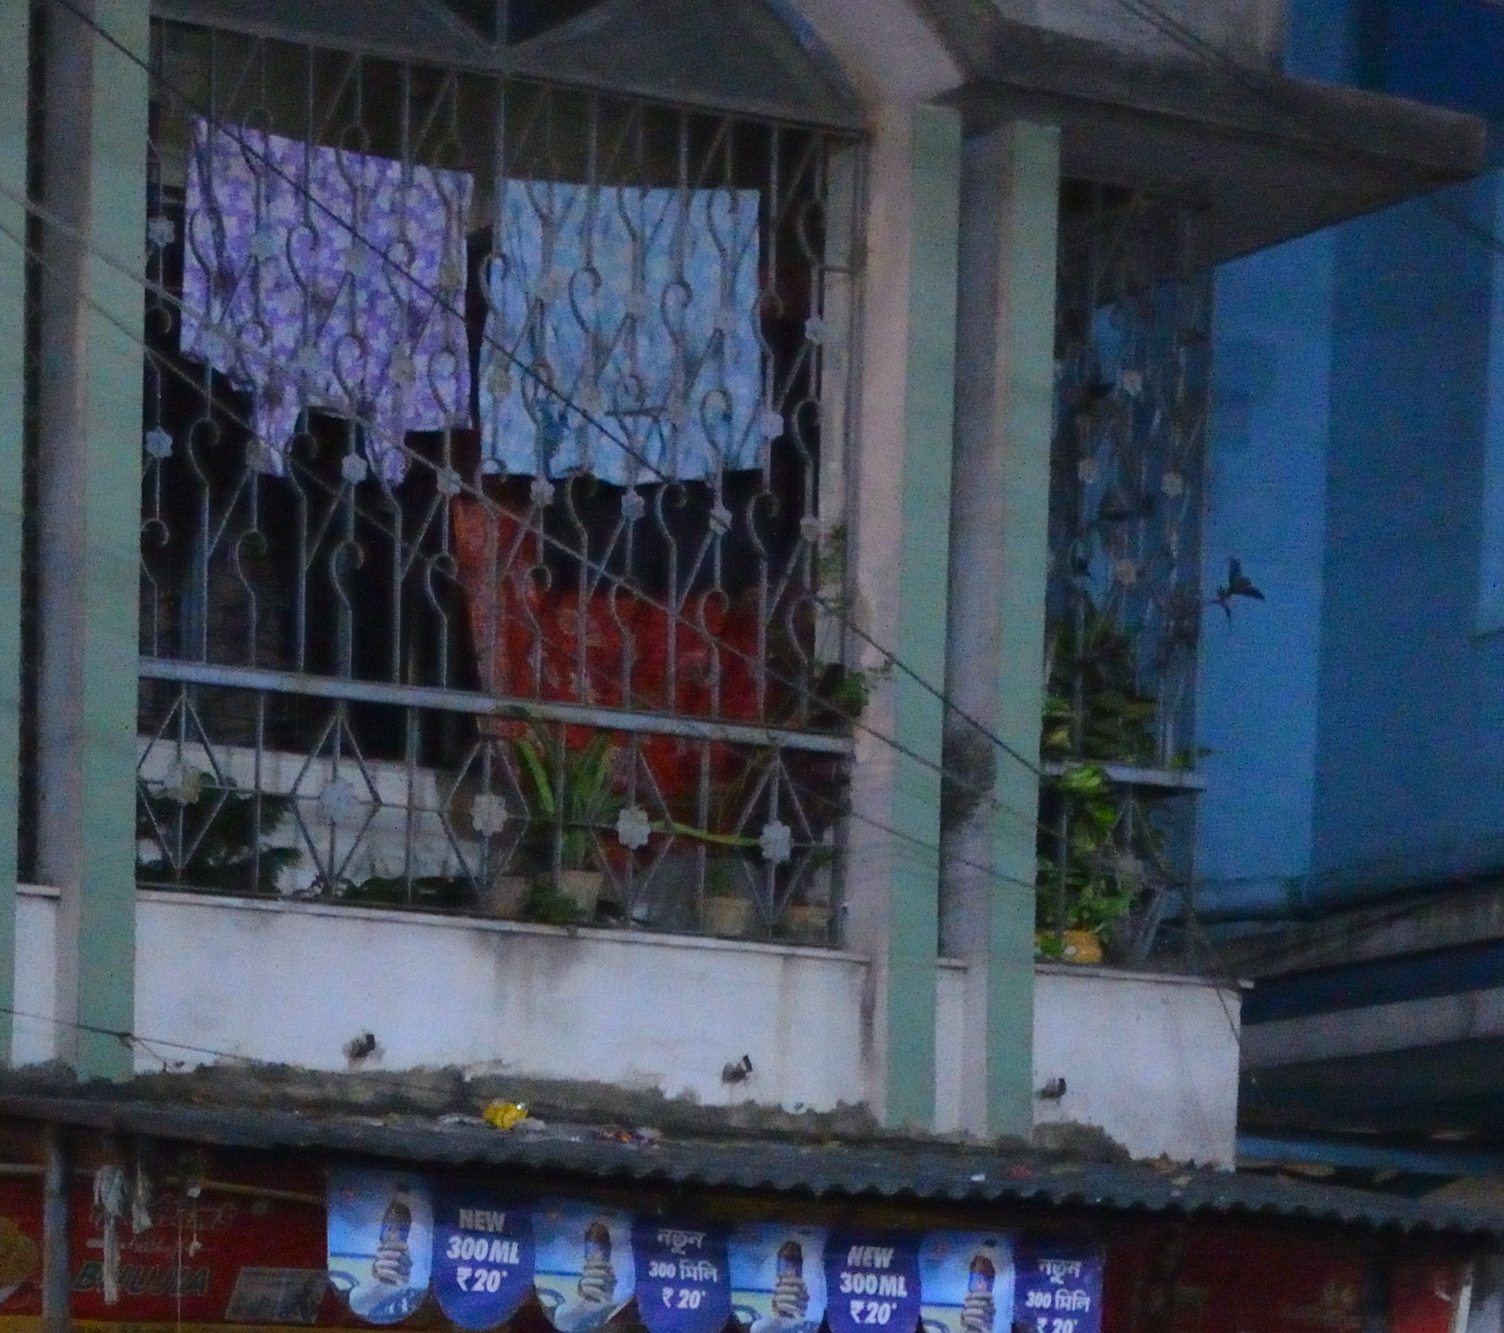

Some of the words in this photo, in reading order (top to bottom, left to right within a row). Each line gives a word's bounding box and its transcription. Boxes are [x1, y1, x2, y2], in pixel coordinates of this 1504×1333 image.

[458, 1208, 506, 1233] NEW
[657, 1229, 706, 1255] নতুন
[846, 1245, 896, 1269] NEW
